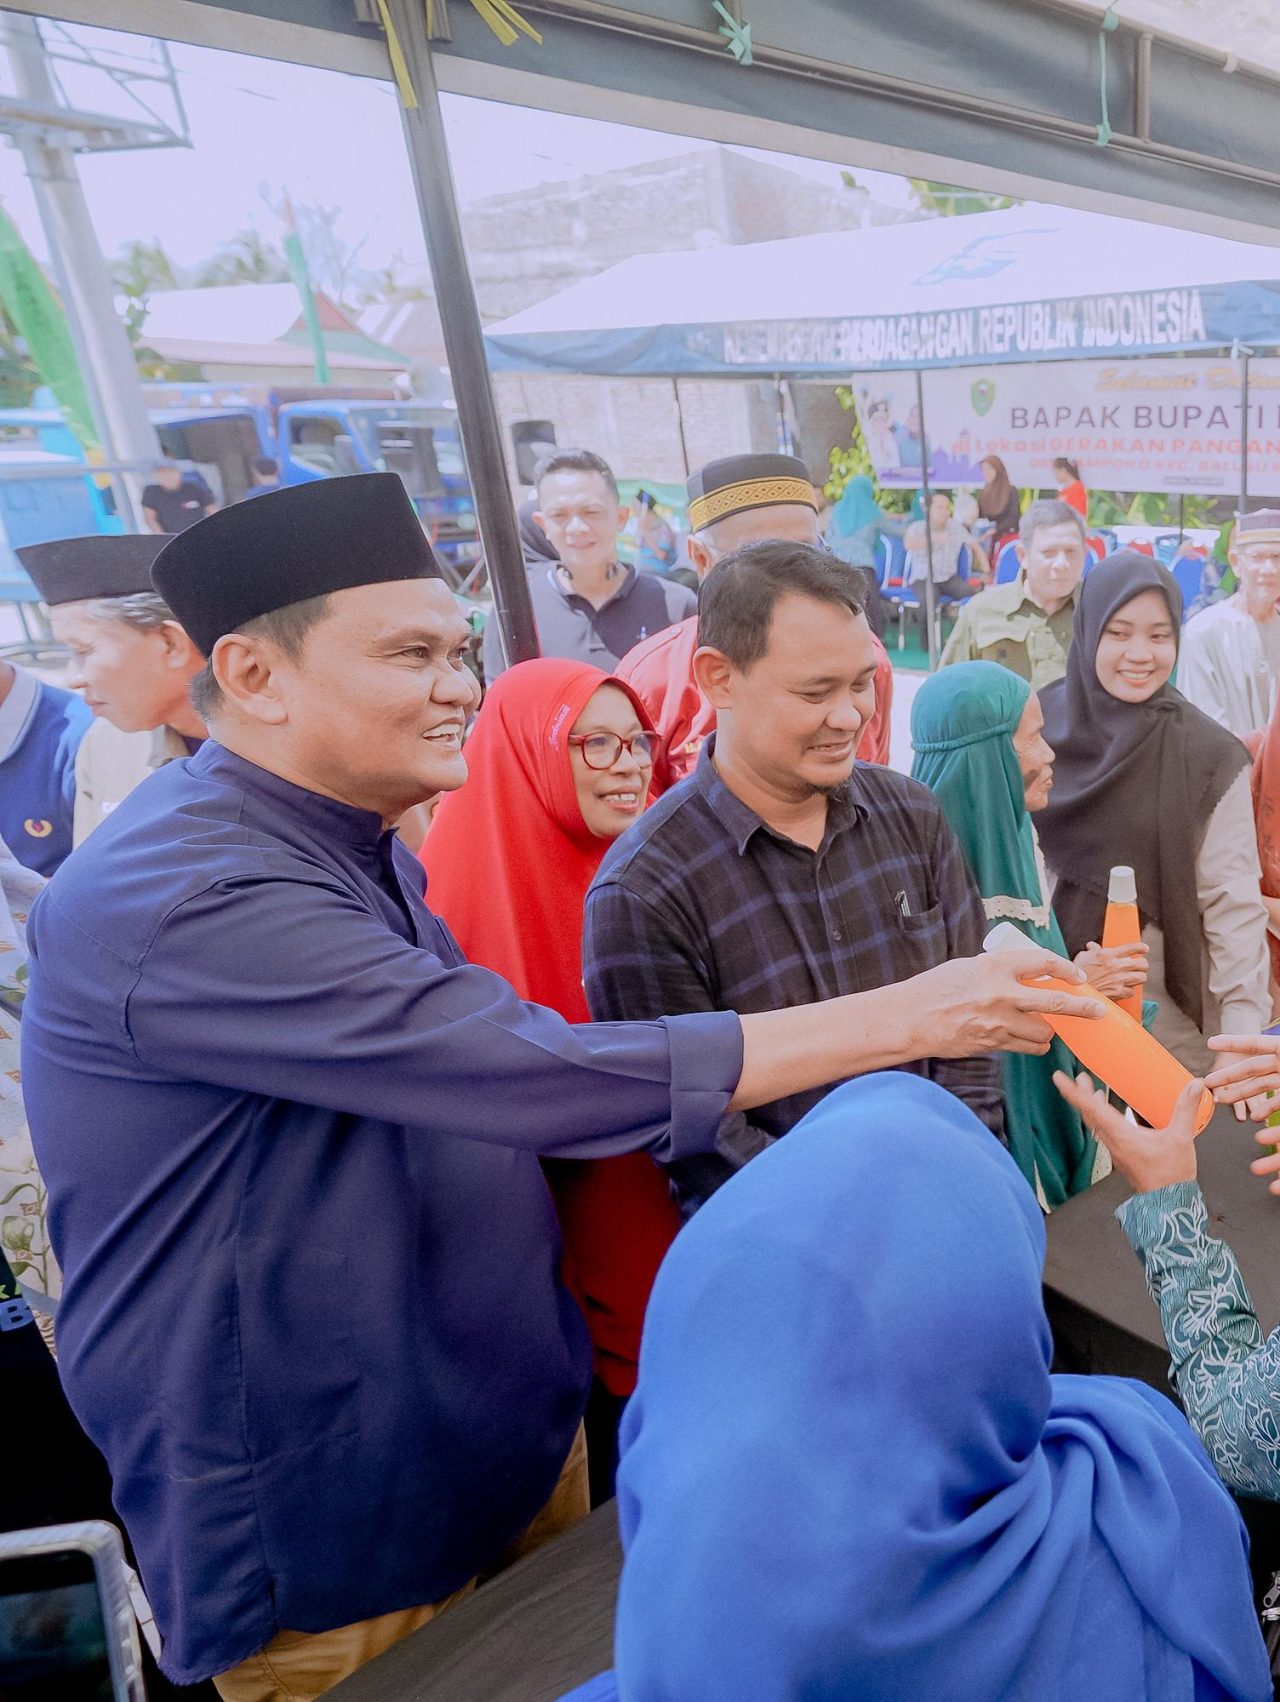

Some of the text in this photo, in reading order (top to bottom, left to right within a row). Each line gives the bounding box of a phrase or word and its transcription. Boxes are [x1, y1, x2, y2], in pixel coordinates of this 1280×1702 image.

[979, 302, 1077, 354] REPUBLIK
[1083, 289, 1207, 347] INDONESIA
[1012, 405, 1120, 429] BAPAK
[1051, 436, 1164, 453] GERAKAN
